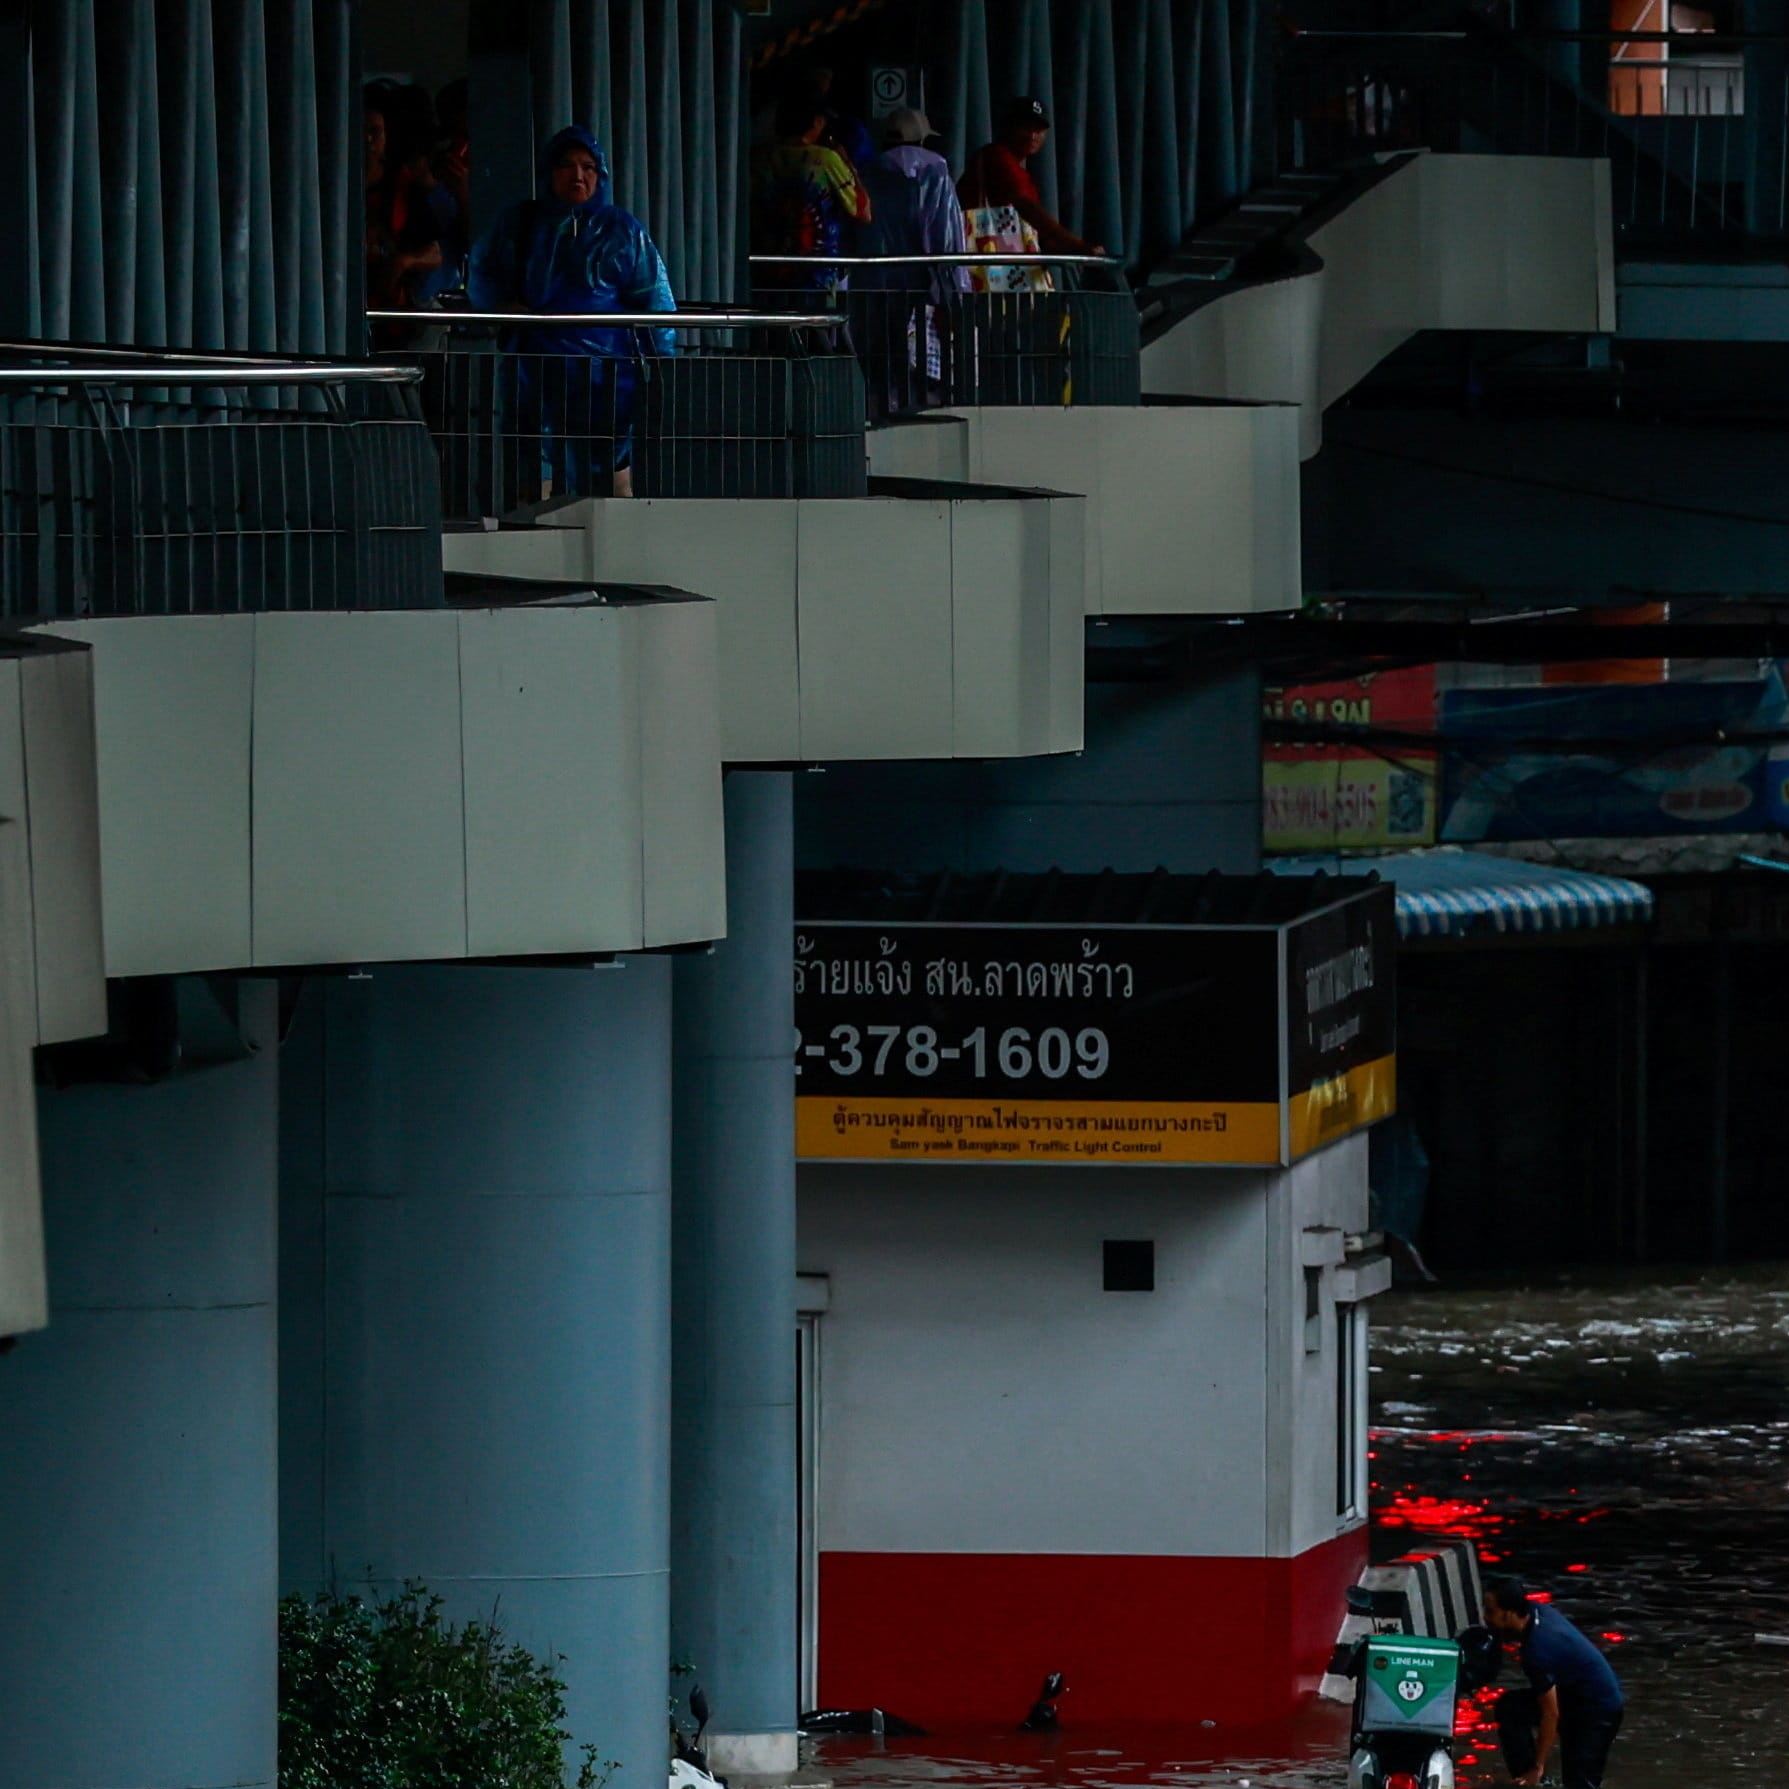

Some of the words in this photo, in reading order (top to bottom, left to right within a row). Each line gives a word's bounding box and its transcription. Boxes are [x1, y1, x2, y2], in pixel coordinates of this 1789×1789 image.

[925, 937, 1135, 998] สน.ลาดพร้าว
[890, 1138, 921, 1151] Sam
[1028, 1139, 1071, 1153] Traffic
[1073, 1140, 1108, 1154] Light
[1111, 1141, 1163, 1154] Control
